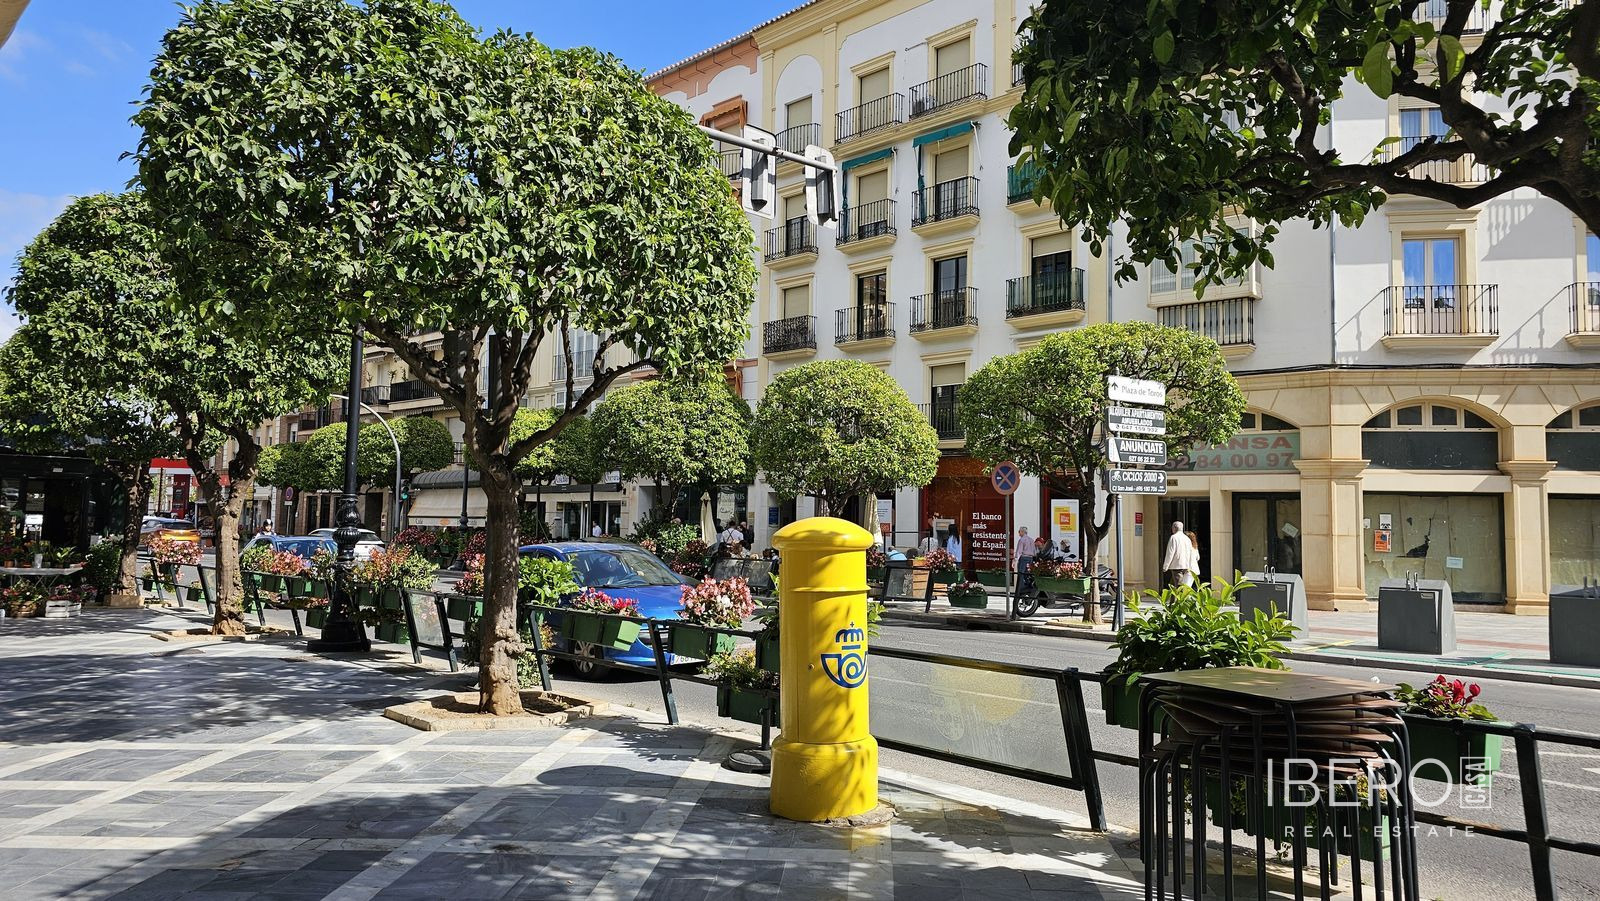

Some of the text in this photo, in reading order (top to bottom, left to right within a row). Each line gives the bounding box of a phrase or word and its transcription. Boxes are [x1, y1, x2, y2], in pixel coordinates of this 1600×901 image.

[1121, 385, 1137, 395] Plaza
[1147, 388, 1163, 398] Toros
[1122, 416, 1153, 427] AMUEBLADOS
[1120, 440, 1164, 454] ANUNCIATE
[1196, 454, 1222, 469] 84
[1230, 453, 1258, 469] 00
[1266, 452, 1295, 468] 97
[1122, 471, 1158, 482] CICLOS 2000
[972, 512, 1002, 521] El banco
[972, 531, 1007, 539] resistente
[972, 540, 981, 548] de
